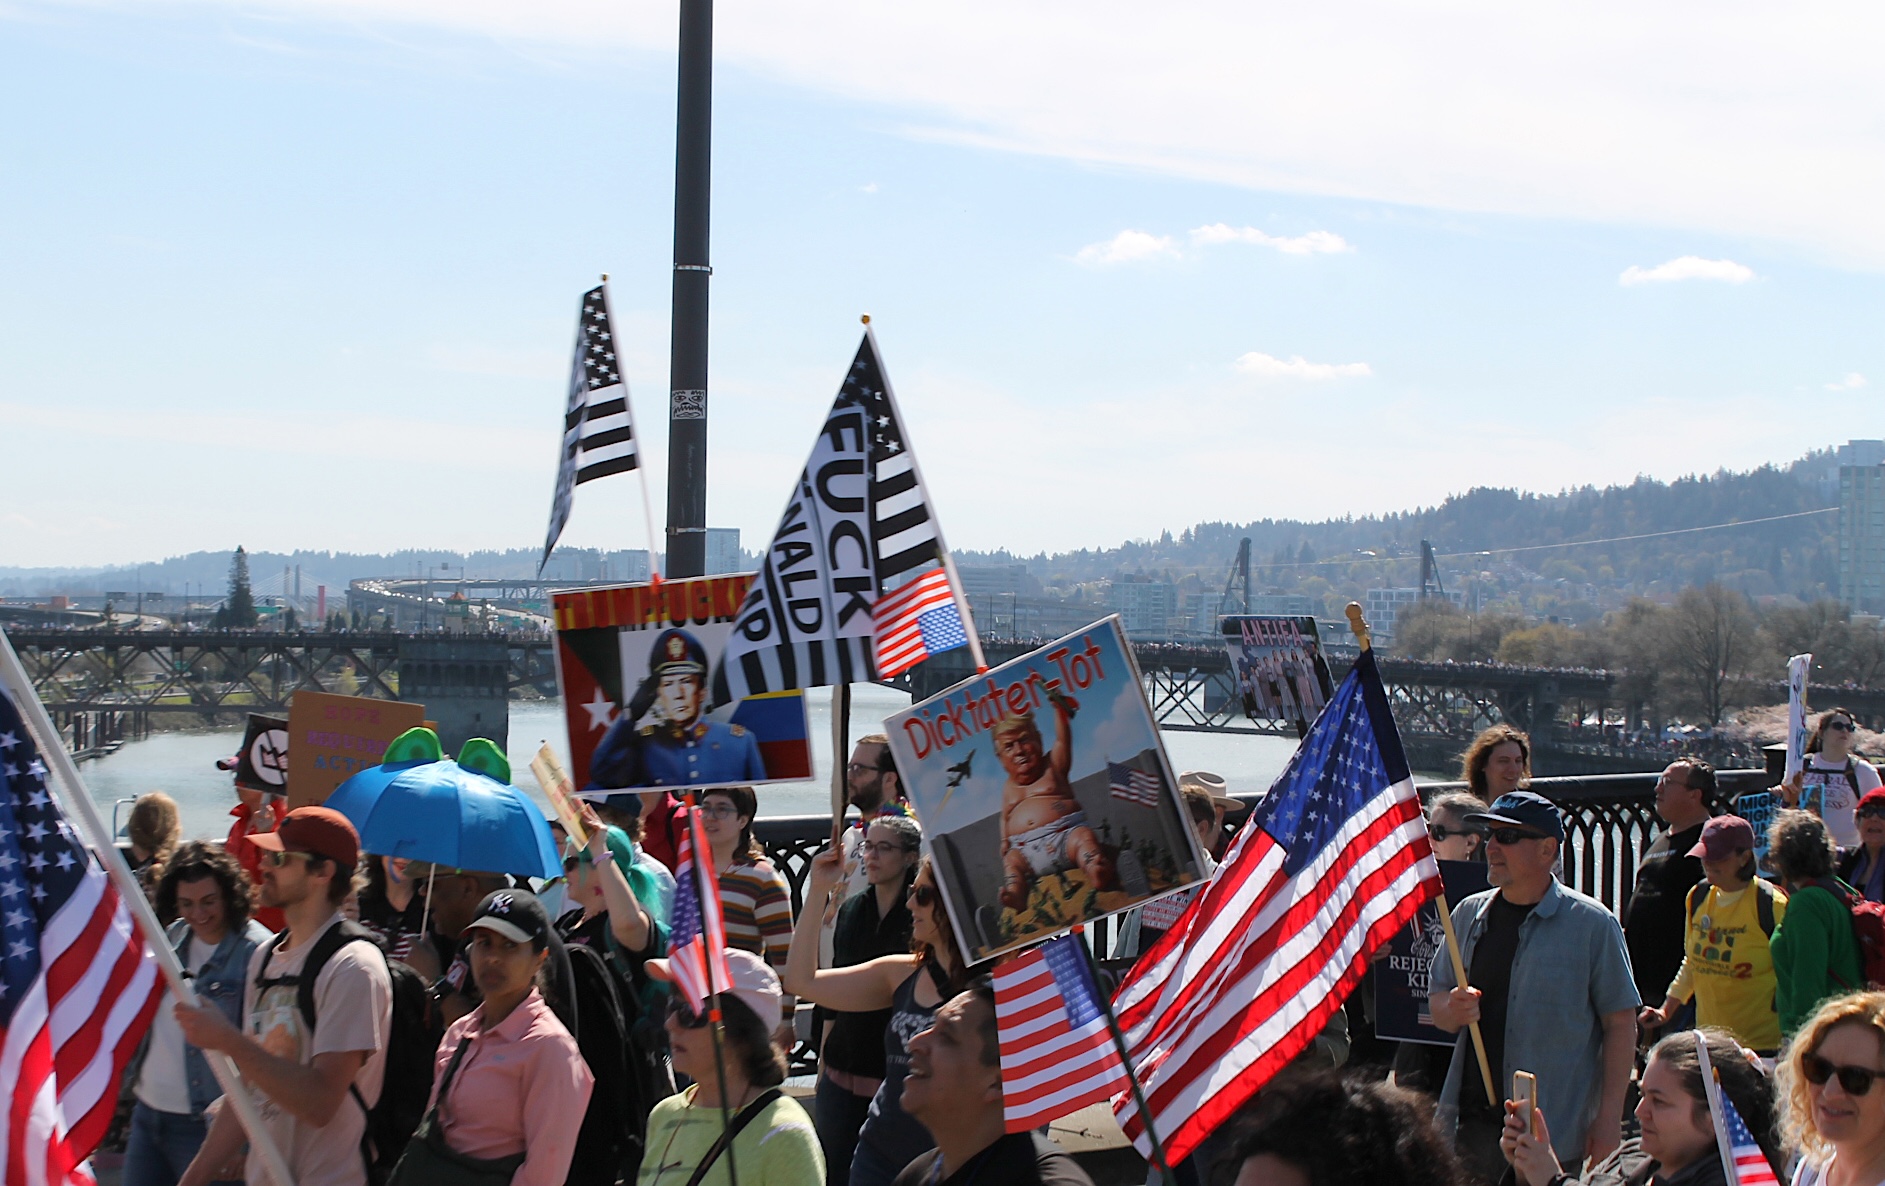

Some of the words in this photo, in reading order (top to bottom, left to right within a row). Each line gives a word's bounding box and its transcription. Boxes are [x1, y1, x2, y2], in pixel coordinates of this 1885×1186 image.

[816, 412, 877, 631] FUCK
[1240, 619, 1304, 647] ANTIFA
[903, 635, 1106, 760] Dicktater-Tot
[324, 705, 380, 725] HOPE
[306, 731, 391, 756] REQUIRE
